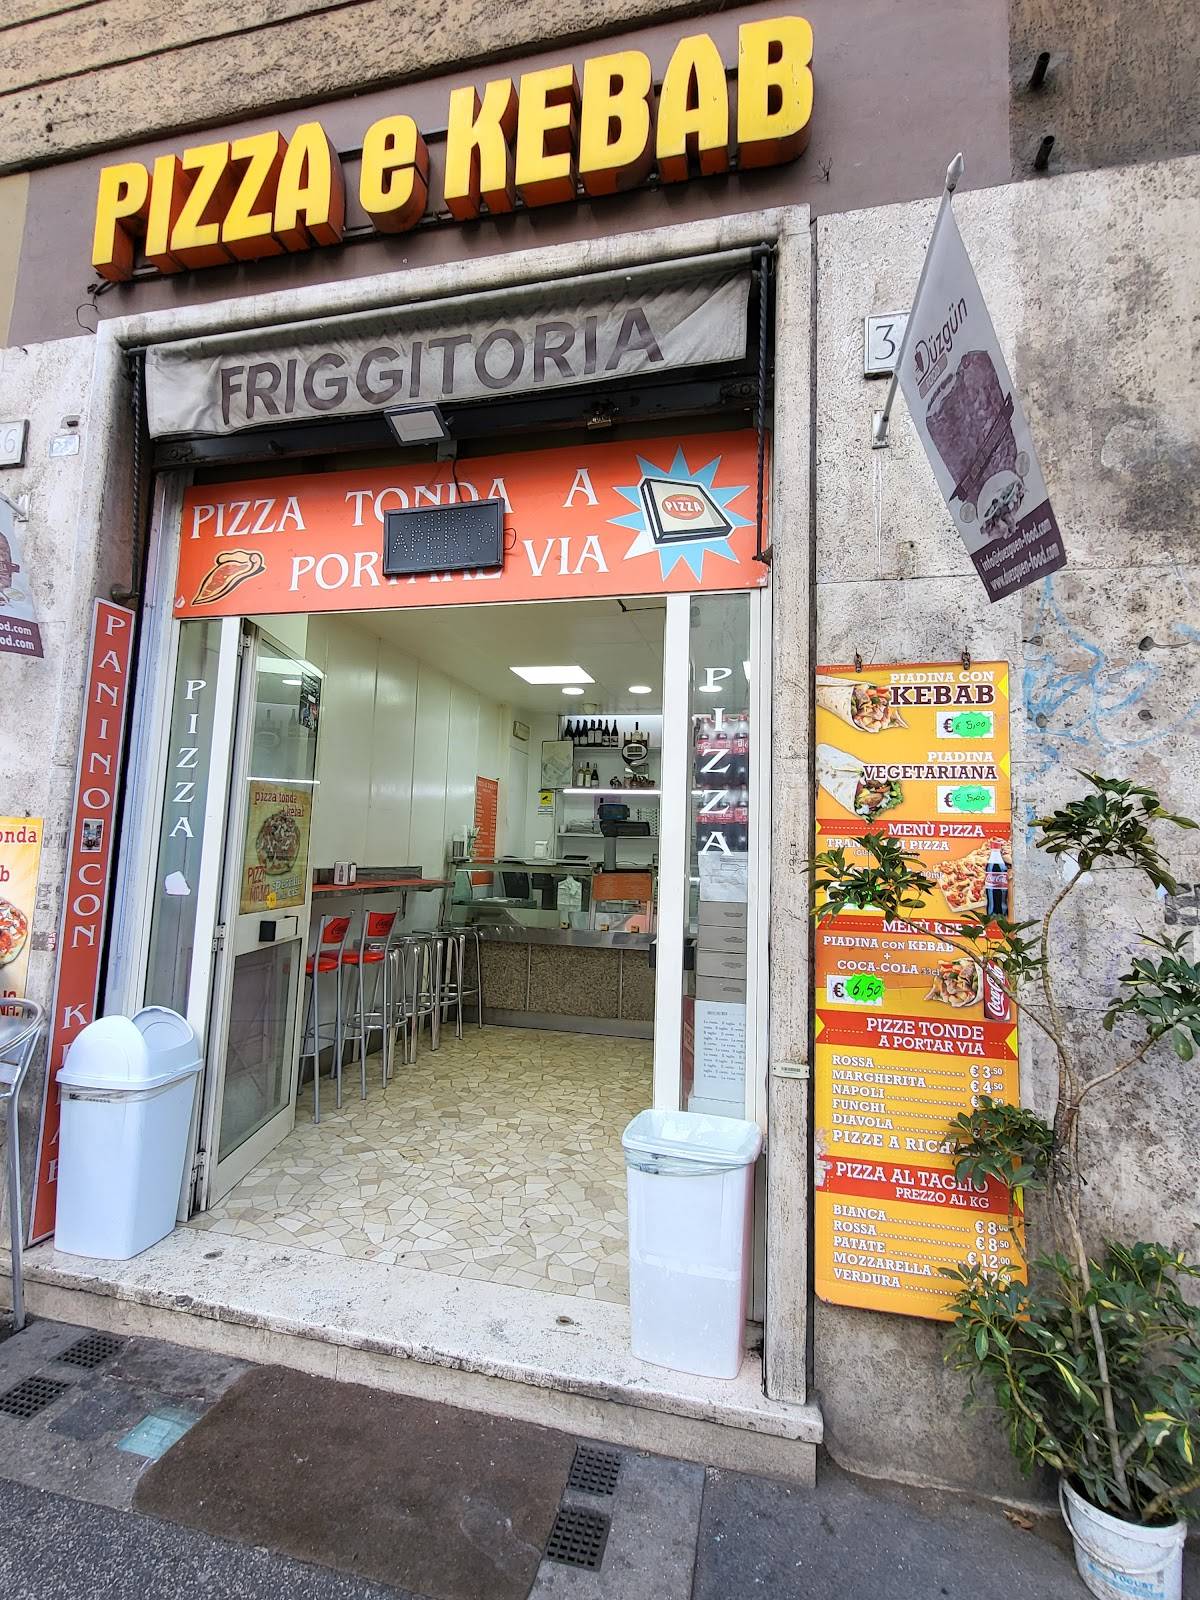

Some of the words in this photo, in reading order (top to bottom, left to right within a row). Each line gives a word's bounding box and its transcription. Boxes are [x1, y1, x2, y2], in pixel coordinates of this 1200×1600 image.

[91, 121, 336, 270] PIZZA
[359, 114, 421, 216] e
[443, 15, 814, 205] KEBAB
[914, 297, 968, 386] Düzgün
[220, 307, 665, 427] FRIGGITORIA
[0, 428, 17, 454] 6
[190, 496, 307, 540] PIZZA
[562, 467, 600, 508] A
[664, 500, 702, 513] PIZZA
[522, 535, 609, 577] VIA
[890, 673, 954, 684] PIADINA
[959, 671, 994, 683] CON
[889, 684, 995, 706] KEBAB
[82, 614, 126, 810] PANINO
[169, 679, 207, 838] PIZZA
[699, 667, 734, 857] PIZZA
[928, 751, 994, 763] PIADINA
[863, 765, 998, 780] VEGETARIANA
[0, 825, 38, 844] nda
[888, 821, 936, 837] MENÙ
[938, 824, 986, 839] PIZZA
[909, 840, 950, 851] PIZZA
[71, 863, 103, 949] CON
[823, 936, 879, 948] PIADINA
[908, 940, 954, 953] KEBAB
[837, 960, 920, 976] COCA-COLA
[832, 982, 845, 999] €
[852, 978, 881, 998] 6,50
[866, 1017, 916, 1036] PIZZE
[918, 1022, 985, 1041] TONDE
[878, 1035, 891, 1048] A
[893, 1036, 955, 1054] PORTAR
[956, 1042, 986, 1056] VIA
[832, 1055, 875, 1068] ROSSA
[969, 1064, 980, 1078] €
[832, 1069, 928, 1088] MARGHERITA
[970, 1080, 980, 1093] €
[832, 1084, 886, 1099] NAPOLI
[832, 1098, 886, 1115] FUNGHI
[832, 1113, 894, 1130] DIAVOLA
[832, 1130, 884, 1147] PIZZE
[889, 1135, 900, 1149] A
[836, 1161, 887, 1182] PIZZA
[890, 1169, 915, 1186] AL
[895, 1187, 947, 1203] PREZZO
[949, 1193, 967, 1206] AL
[969, 1197, 990, 1209] KG
[833, 1204, 888, 1221] BIANCA
[974, 1220, 985, 1234] €
[833, 1220, 878, 1236] ROSSA
[975, 1236, 985, 1251] €
[833, 1235, 886, 1253] PATATE
[967, 1251, 977, 1266] €
[833, 1251, 932, 1276] MOZZARELLA
[834, 1267, 901, 1288] VERDURA
